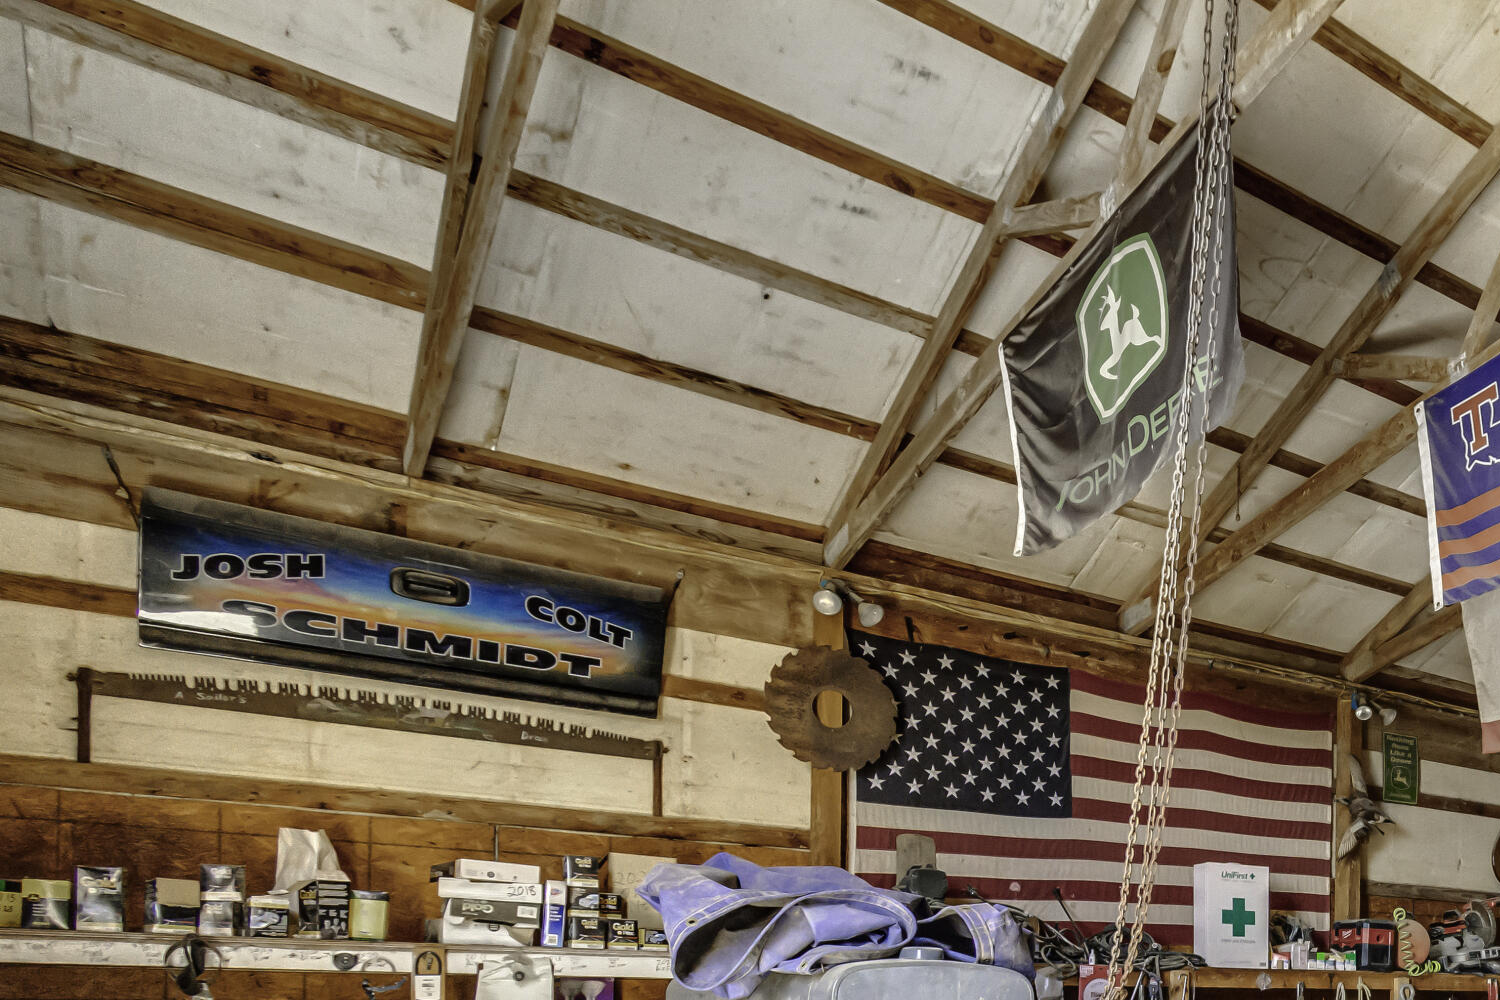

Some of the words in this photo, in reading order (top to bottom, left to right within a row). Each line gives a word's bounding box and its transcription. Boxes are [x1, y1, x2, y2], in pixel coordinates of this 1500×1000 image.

[1055, 440, 1129, 512] JOHN
[1127, 354, 1223, 457] DEEE
[171, 553, 326, 581] JOSH
[223, 599, 602, 679] SCHMIDT
[525, 595, 632, 649] COLT
[507, 885, 537, 898] 2018
[1221, 870, 1248, 880] UniFirst
